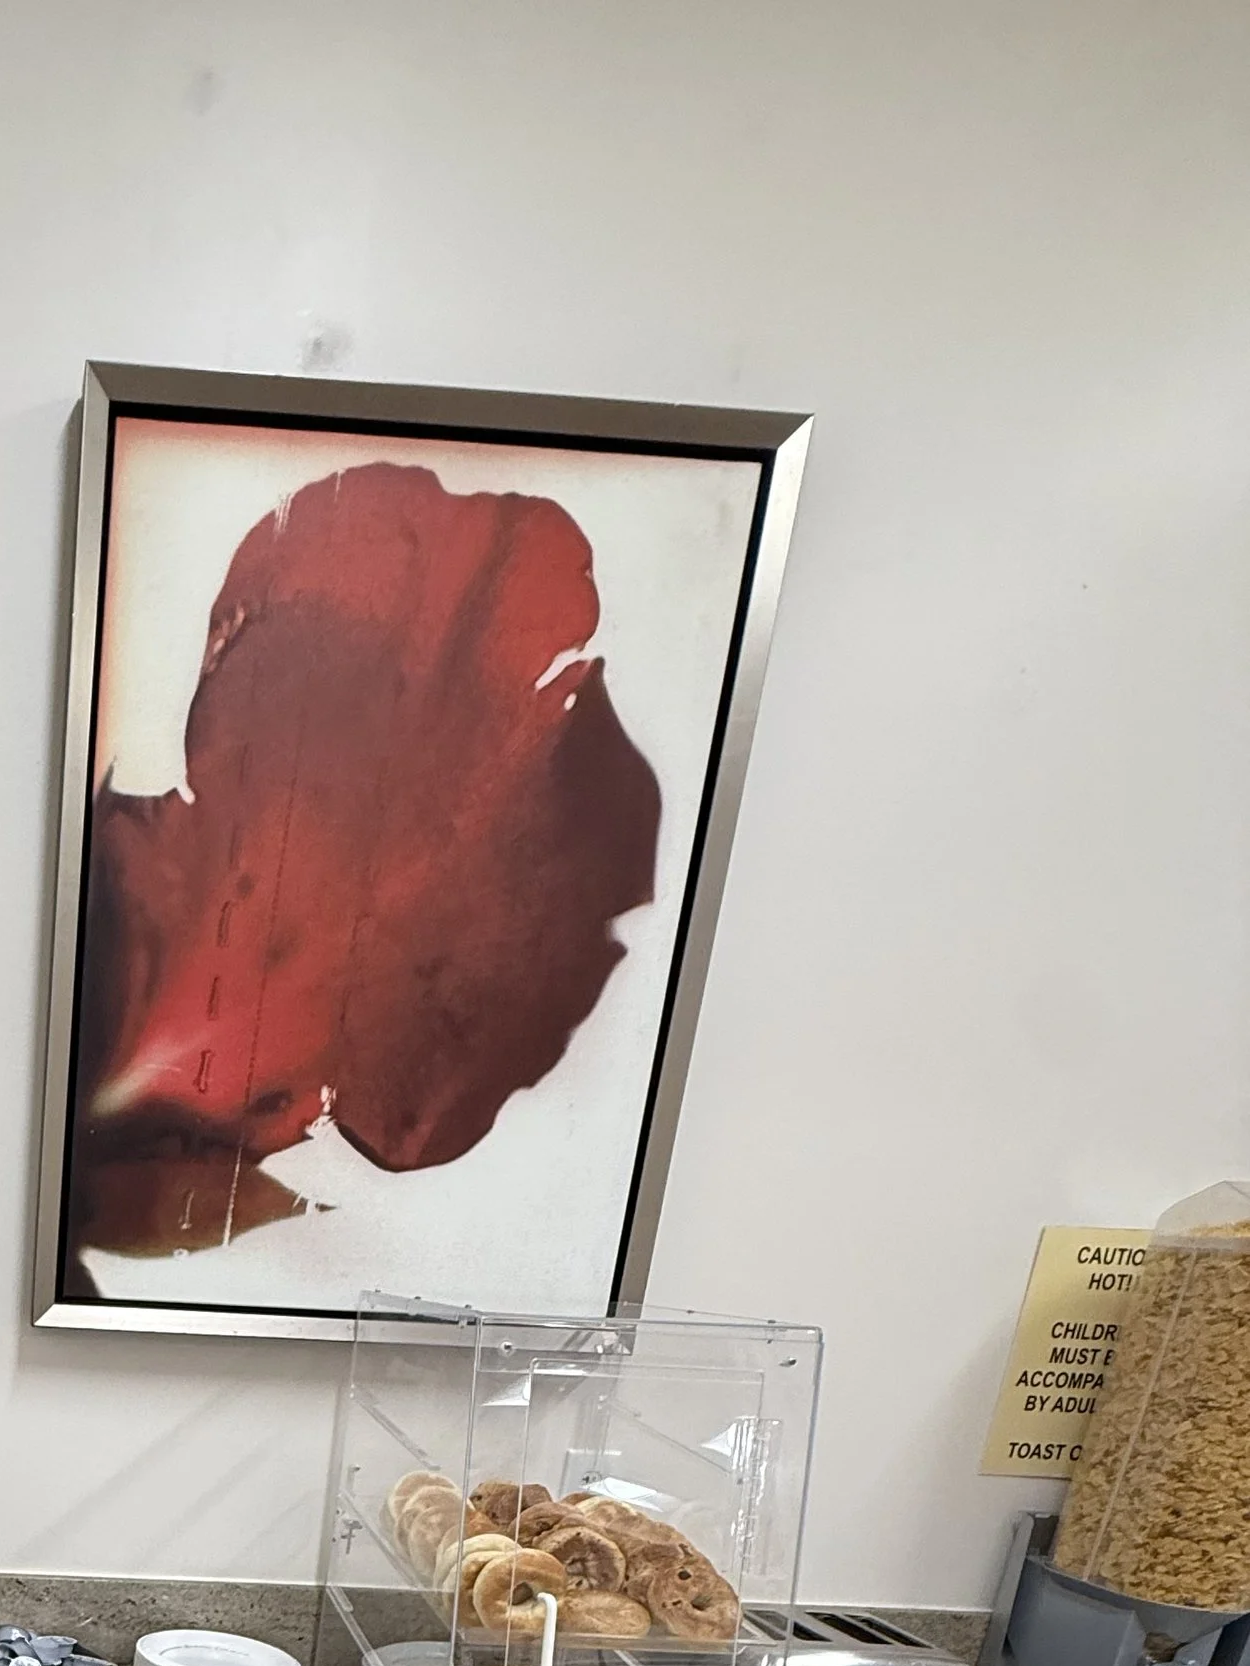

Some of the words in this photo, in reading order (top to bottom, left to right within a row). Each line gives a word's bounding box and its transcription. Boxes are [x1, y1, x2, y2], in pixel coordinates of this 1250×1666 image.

[1051, 1322, 1118, 1342] CHILDR
[1049, 1347, 1101, 1365] MUST
[1024, 1395, 1050, 1412] BY
[1008, 1442, 1067, 1461] TOAST
